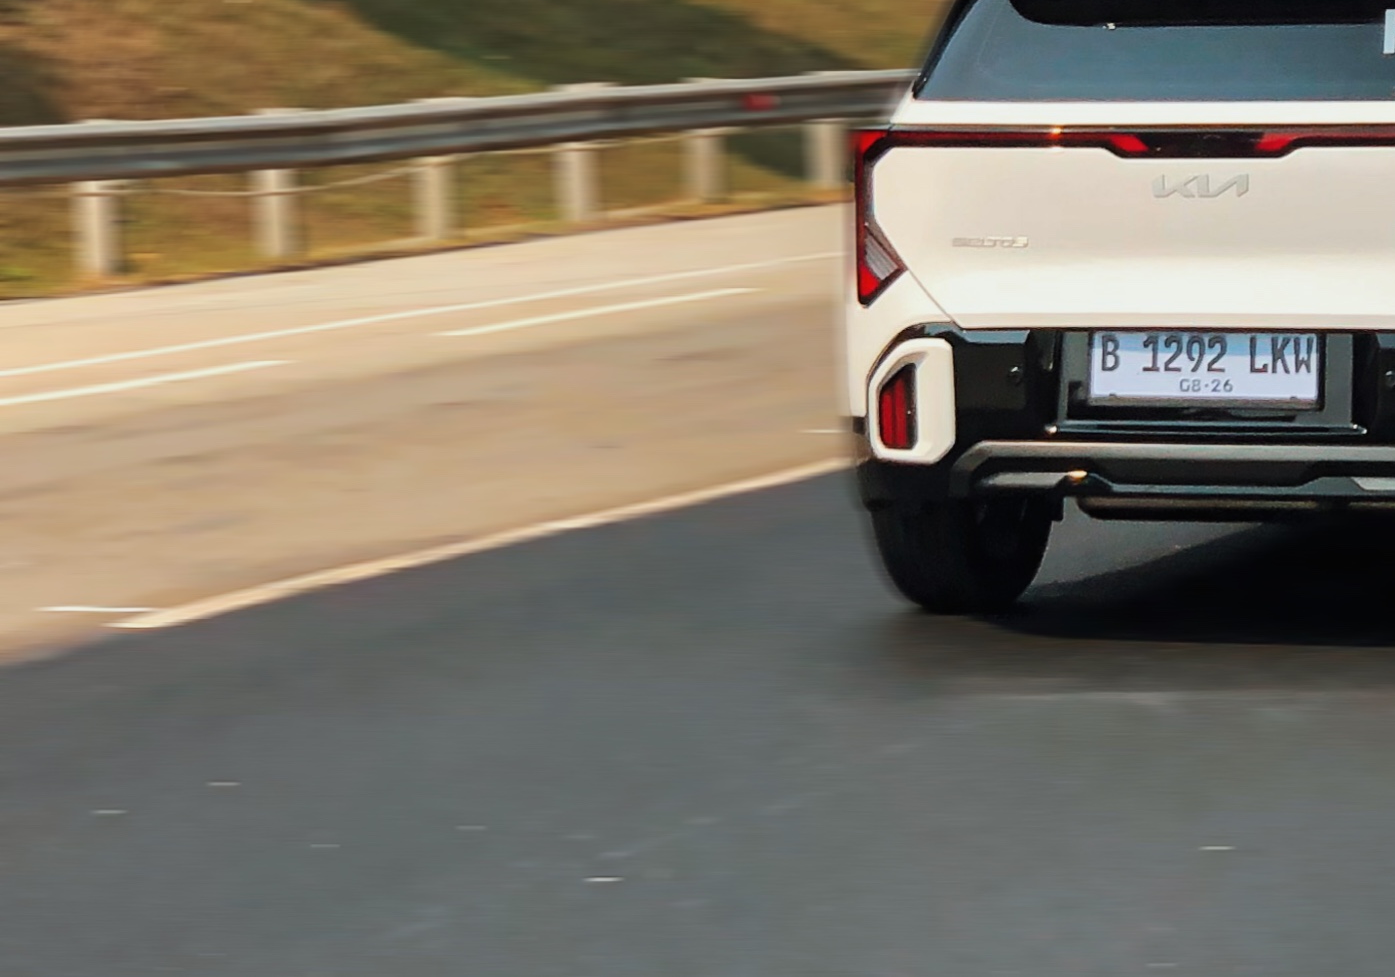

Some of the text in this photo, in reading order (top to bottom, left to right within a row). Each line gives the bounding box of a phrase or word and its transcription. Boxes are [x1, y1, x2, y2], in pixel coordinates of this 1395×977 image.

[1101, 334, 1315, 375] B 1292 LKW
